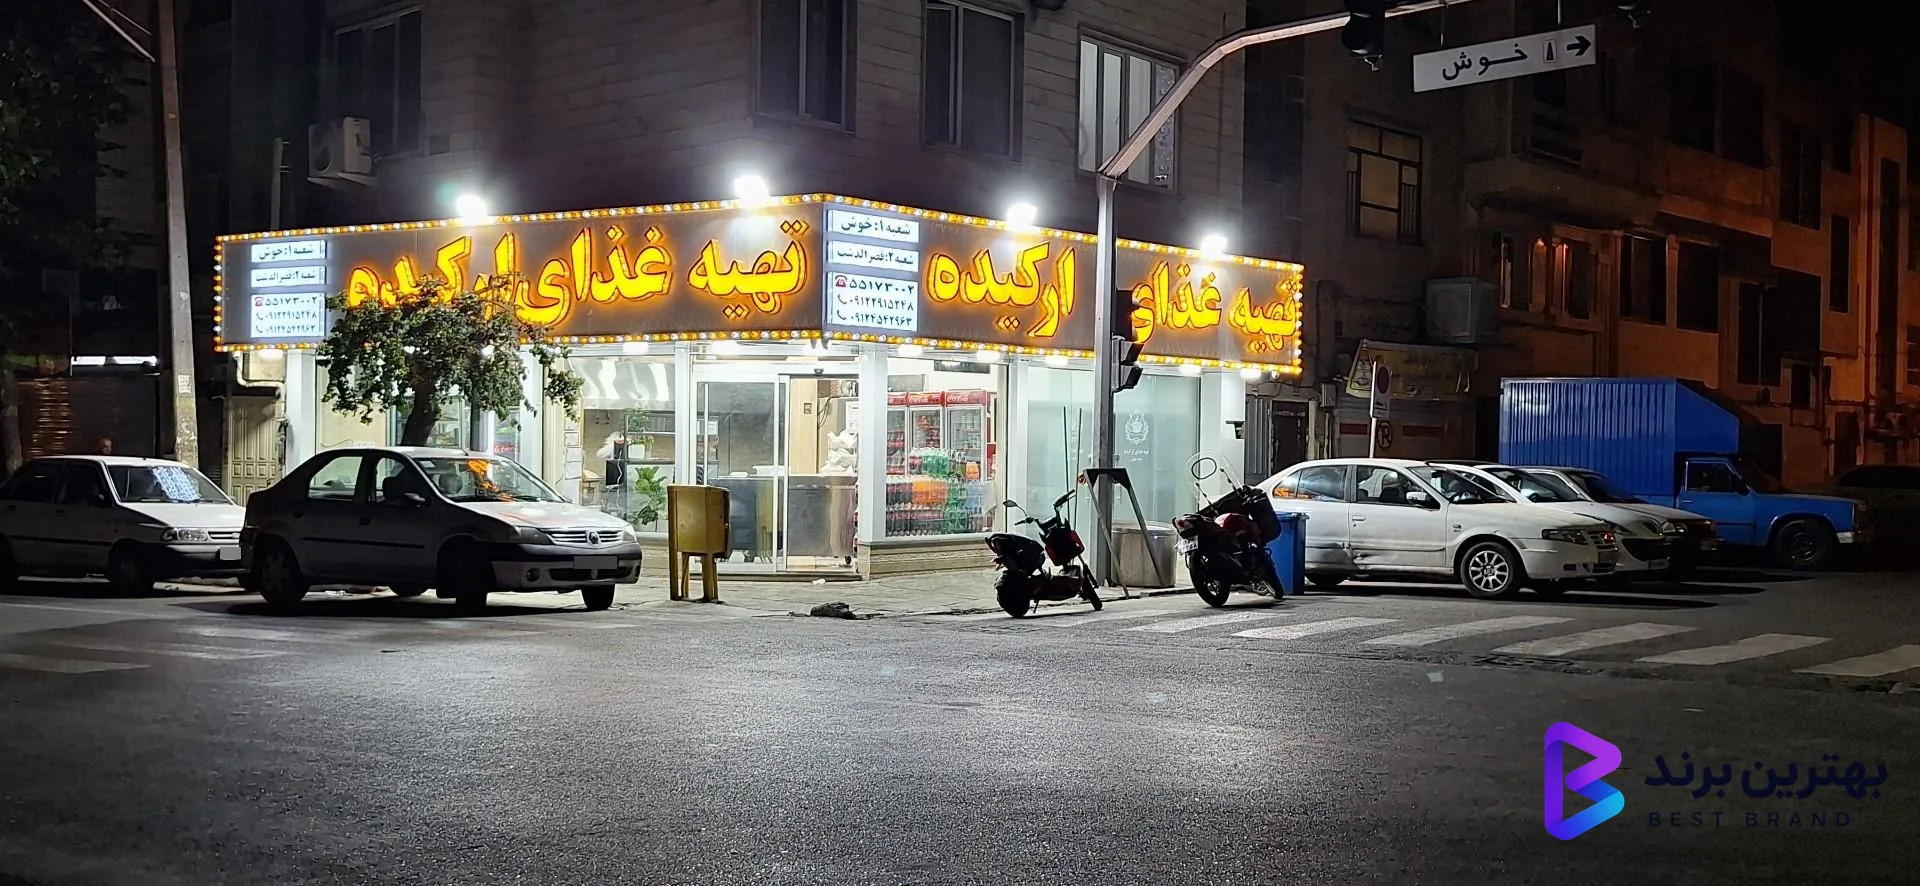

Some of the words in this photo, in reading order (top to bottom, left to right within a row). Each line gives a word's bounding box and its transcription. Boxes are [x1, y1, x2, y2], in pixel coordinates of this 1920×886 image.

[1442, 42, 1528, 81] خوش
[348, 231, 515, 321] ارکده
[514, 224, 673, 326] غذای
[687, 219, 810, 320] تهیه
[849, 278, 915, 295] ۵۵۱۷۳۰۰۲
[926, 240, 1076, 338] ارکیده
[1228, 280, 1298, 354] تهیه
